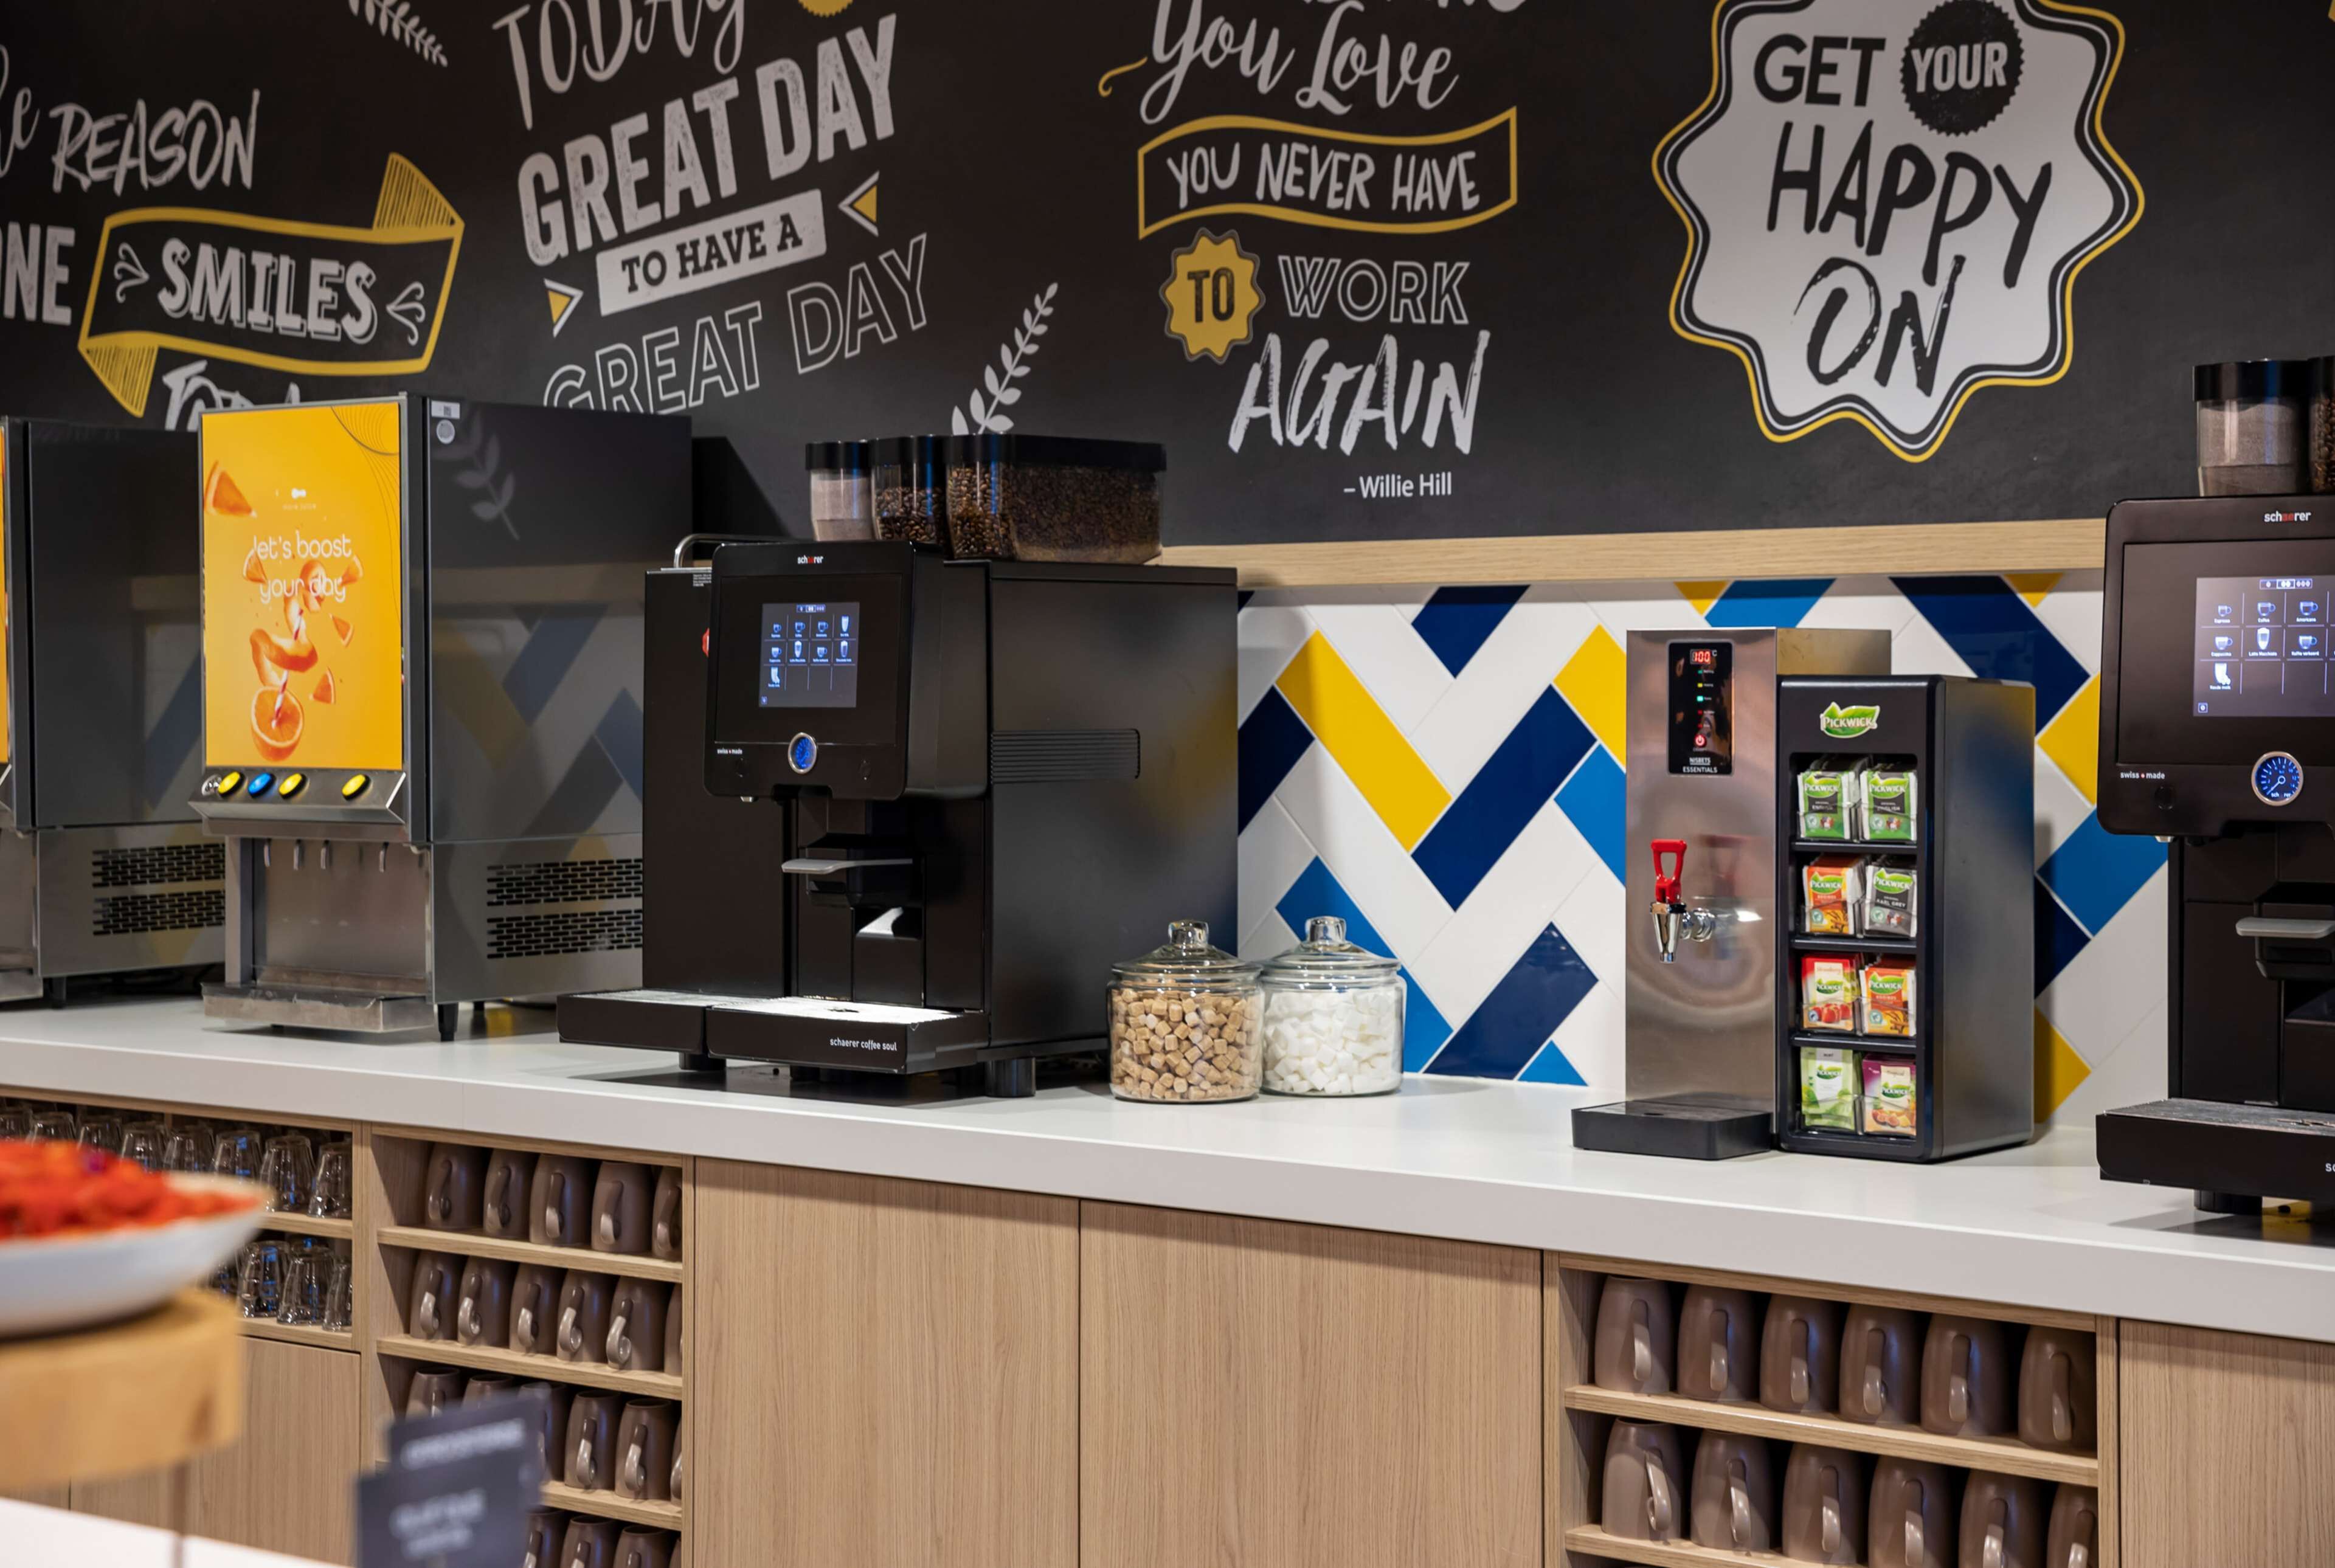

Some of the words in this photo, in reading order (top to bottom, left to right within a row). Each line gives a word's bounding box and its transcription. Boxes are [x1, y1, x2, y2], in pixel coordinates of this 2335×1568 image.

[1140, 0, 1295, 125] You
[1296, 0, 1459, 115] Love
[1754, 33, 1886, 106] GET
[1910, 41, 2007, 94] YOUR
[49, 89, 260, 195] REASON
[518, 77, 740, 266] GREAT
[755, 13, 897, 180] DAY
[1167, 142, 1240, 209] YOU
[1256, 143, 1375, 210] NEVER
[1392, 151, 1480, 212] HAVE
[1767, 119, 2052, 289] HAPPY
[0, 221, 75, 326] NE
[621, 250, 668, 294] TO
[678, 222, 767, 278] HAVE
[776, 213, 803, 250] A
[1187, 267, 1235, 323] TO
[1278, 255, 1470, 325] WORK
[157, 238, 378, 345] SMILES
[787, 232, 927, 375] DAY
[1792, 255, 1965, 397] ON
[1228, 330, 1490, 455] AGAIN
[1419, 472, 1452, 497] Hill
[2264, 511, 2311, 522] schaerer
[253, 536, 291, 559] let's
[296, 530, 351, 558] boost
[260, 578, 305, 604] your
[1694, 651, 1711, 663] 100
[1823, 716, 1875, 728] PICKWICK
[2120, 770, 2139, 779] swiss
[2146, 771, 2165, 779] made
[830, 1037, 859, 1048] schaerer
[861, 1040, 880, 1050] coffee
[882, 1042, 897, 1051] soul
